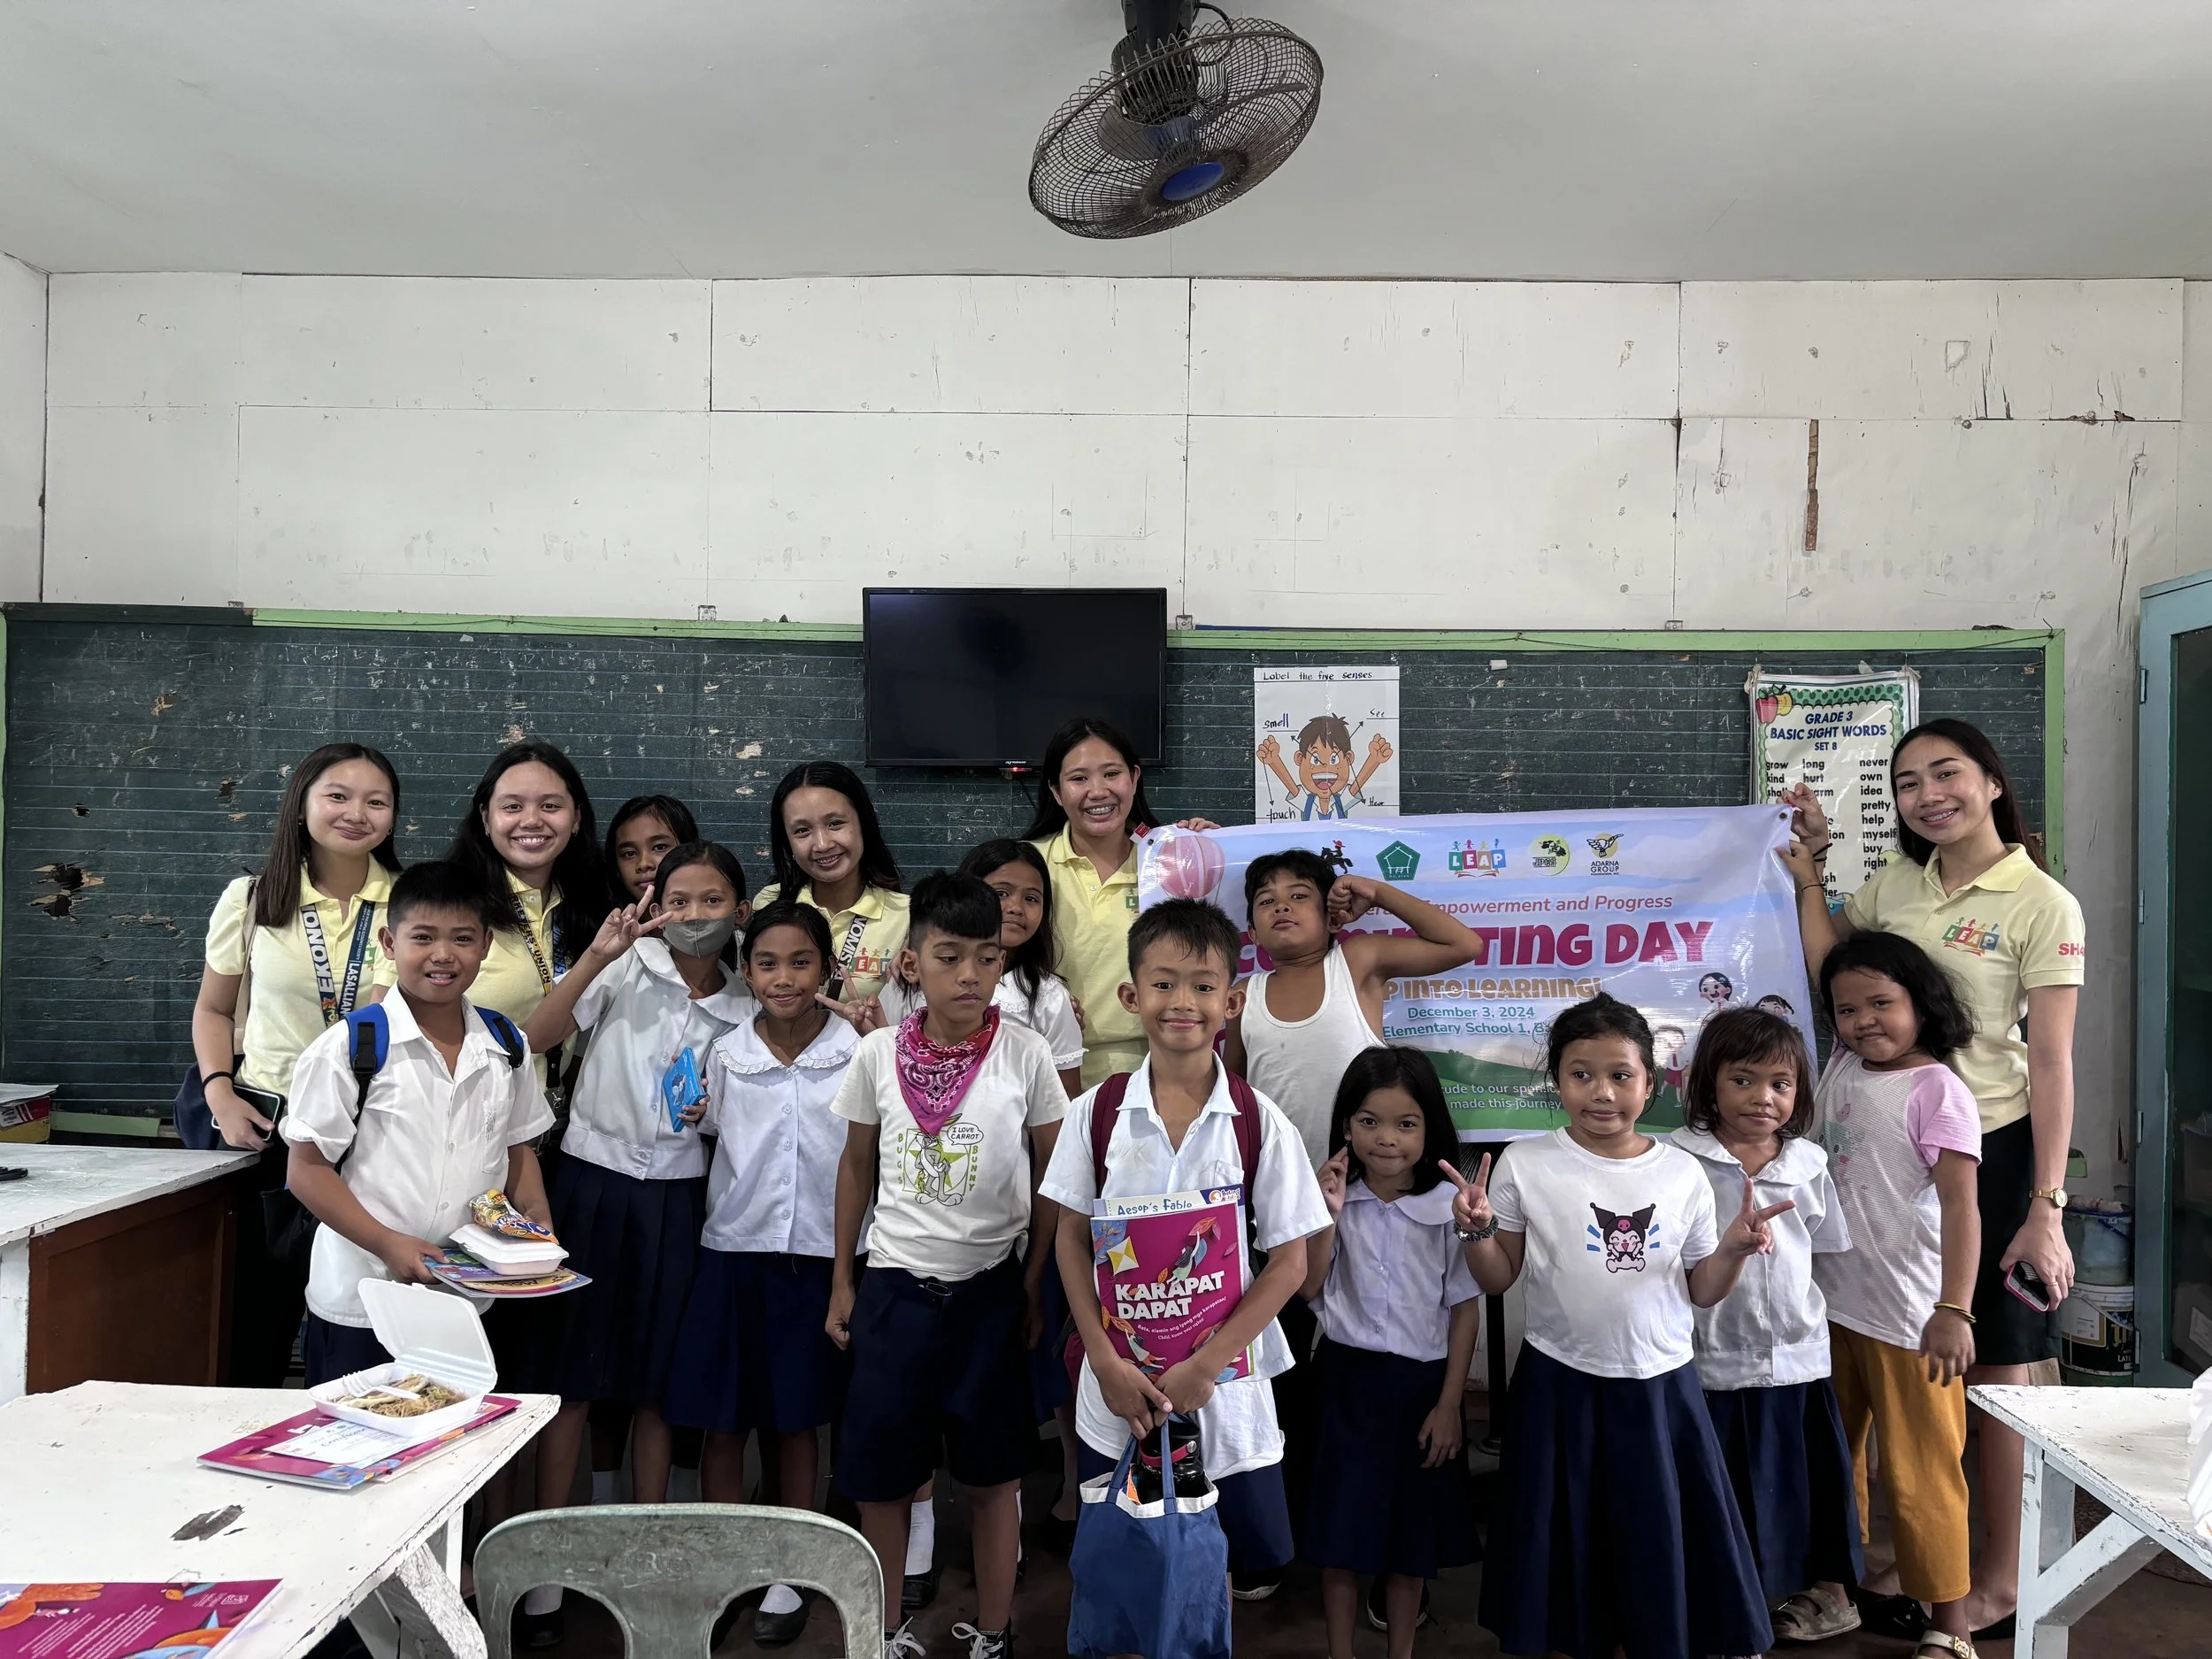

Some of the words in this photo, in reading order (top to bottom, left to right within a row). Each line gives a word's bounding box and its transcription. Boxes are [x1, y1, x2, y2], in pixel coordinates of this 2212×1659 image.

[1318, 671, 1334, 680] five
[1263, 712, 1289, 729] smell
[1805, 711, 1844, 725] GRADE
[1846, 710, 1854, 722] 3
[1770, 727, 1805, 740] BASIC
[1807, 726, 1839, 739] SIGHT
[1842, 724, 1887, 737] WORDS
[1814, 741, 1829, 751] SET
[1832, 741, 1838, 750] 8
[1765, 761, 1789, 771] grow
[1801, 758, 1825, 771] long
[1859, 758, 1888, 767] never
[1766, 773, 1785, 784] kind
[1803, 773, 1824, 783] hurt
[1860, 772, 1883, 781] own
[1812, 788, 1834, 797] arm
[1860, 785, 1883, 795] idea
[1861, 800, 1891, 812] pretty
[1266, 806, 1296, 824] touch
[1862, 814, 1885, 826] help
[1862, 827, 1898, 841] myself
[1863, 842, 1883, 855] buy
[1452, 852, 1504, 867] LEAP
[1863, 856, 1888, 870] right
[1425, 897, 1551, 915] mpowerment
[1556, 896, 1590, 911] and
[1594, 895, 1673, 912] Progress
[511, 893, 537, 947] RKETERS'
[534, 949, 551, 984] UNION
[1605, 920, 1714, 964] DAY
[1947, 928, 1995, 947] LEAP
[1403, 978, 1463, 1000] INTO
[1408, 1006, 1478, 1019] December
[1482, 1007, 1494, 1020] 3,
[1500, 1006, 1536, 1018] 2024
[1383, 1024, 1461, 1039] Elementary
[1465, 1022, 1512, 1034] School
[1518, 1023, 1531, 1036] 1,
[1471, 1084, 1484, 1094] to
[1488, 1085, 1509, 1094] our
[1450, 1098, 1486, 1110] made
[1488, 1097, 1512, 1109] this
[1514, 1096, 1562, 1111] journey
[1117, 1202, 1158, 1216] Aesop's
[1114, 1270, 1225, 1302] KARAPAT
[1117, 1297, 1192, 1320] DAPAT
